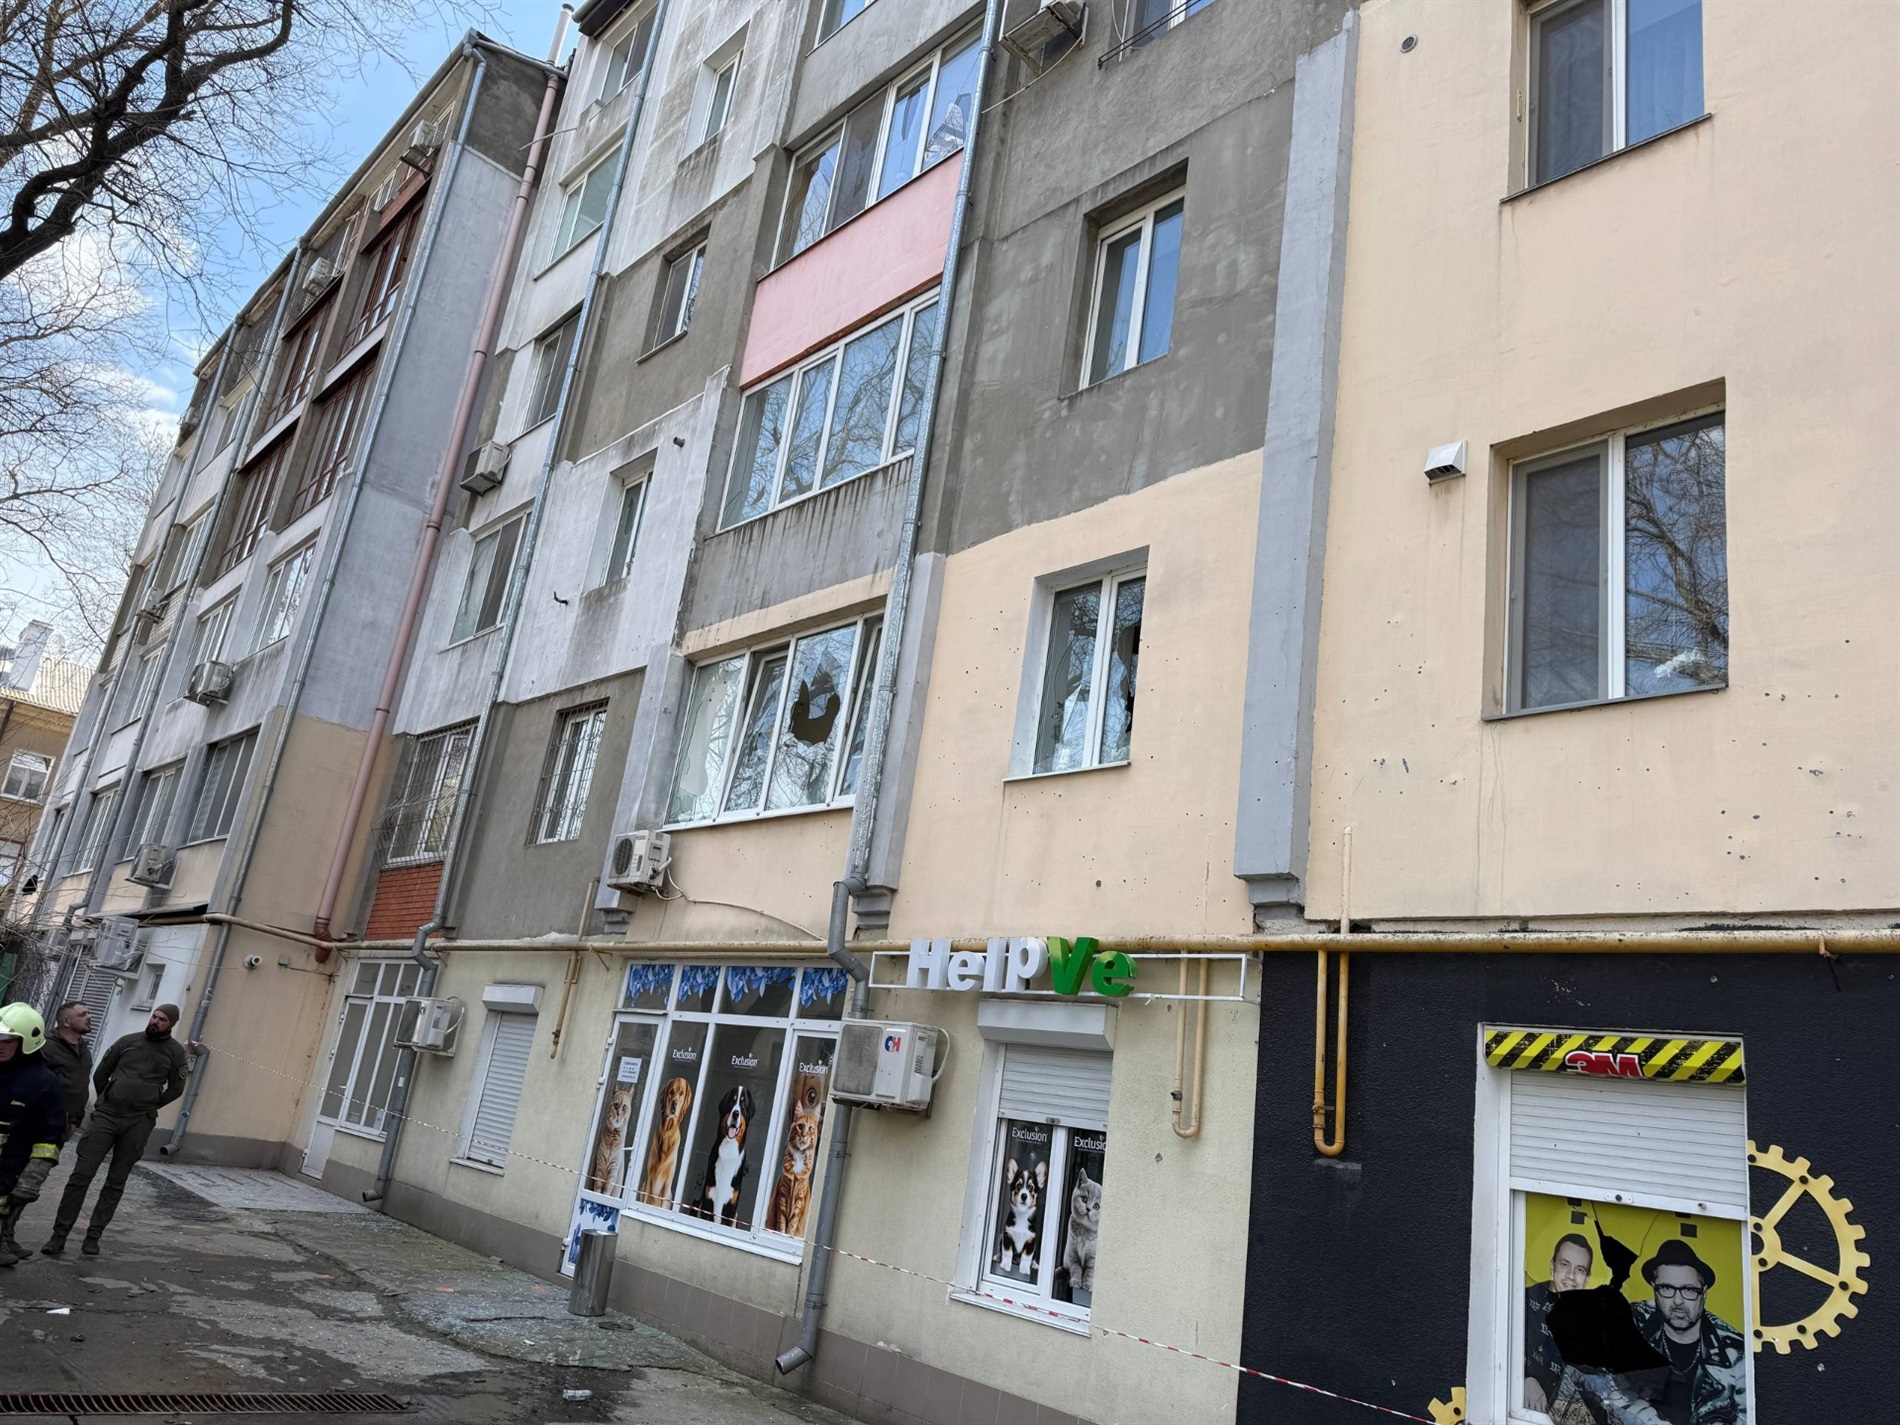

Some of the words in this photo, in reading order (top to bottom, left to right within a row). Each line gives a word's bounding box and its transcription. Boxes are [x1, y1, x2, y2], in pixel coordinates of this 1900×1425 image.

[672, 1046, 697, 1060] Exclusion
[731, 1053, 758, 1067] Exclusion
[798, 1060, 829, 1075] Exclusion
[1011, 1126, 1048, 1143] Exclusion
